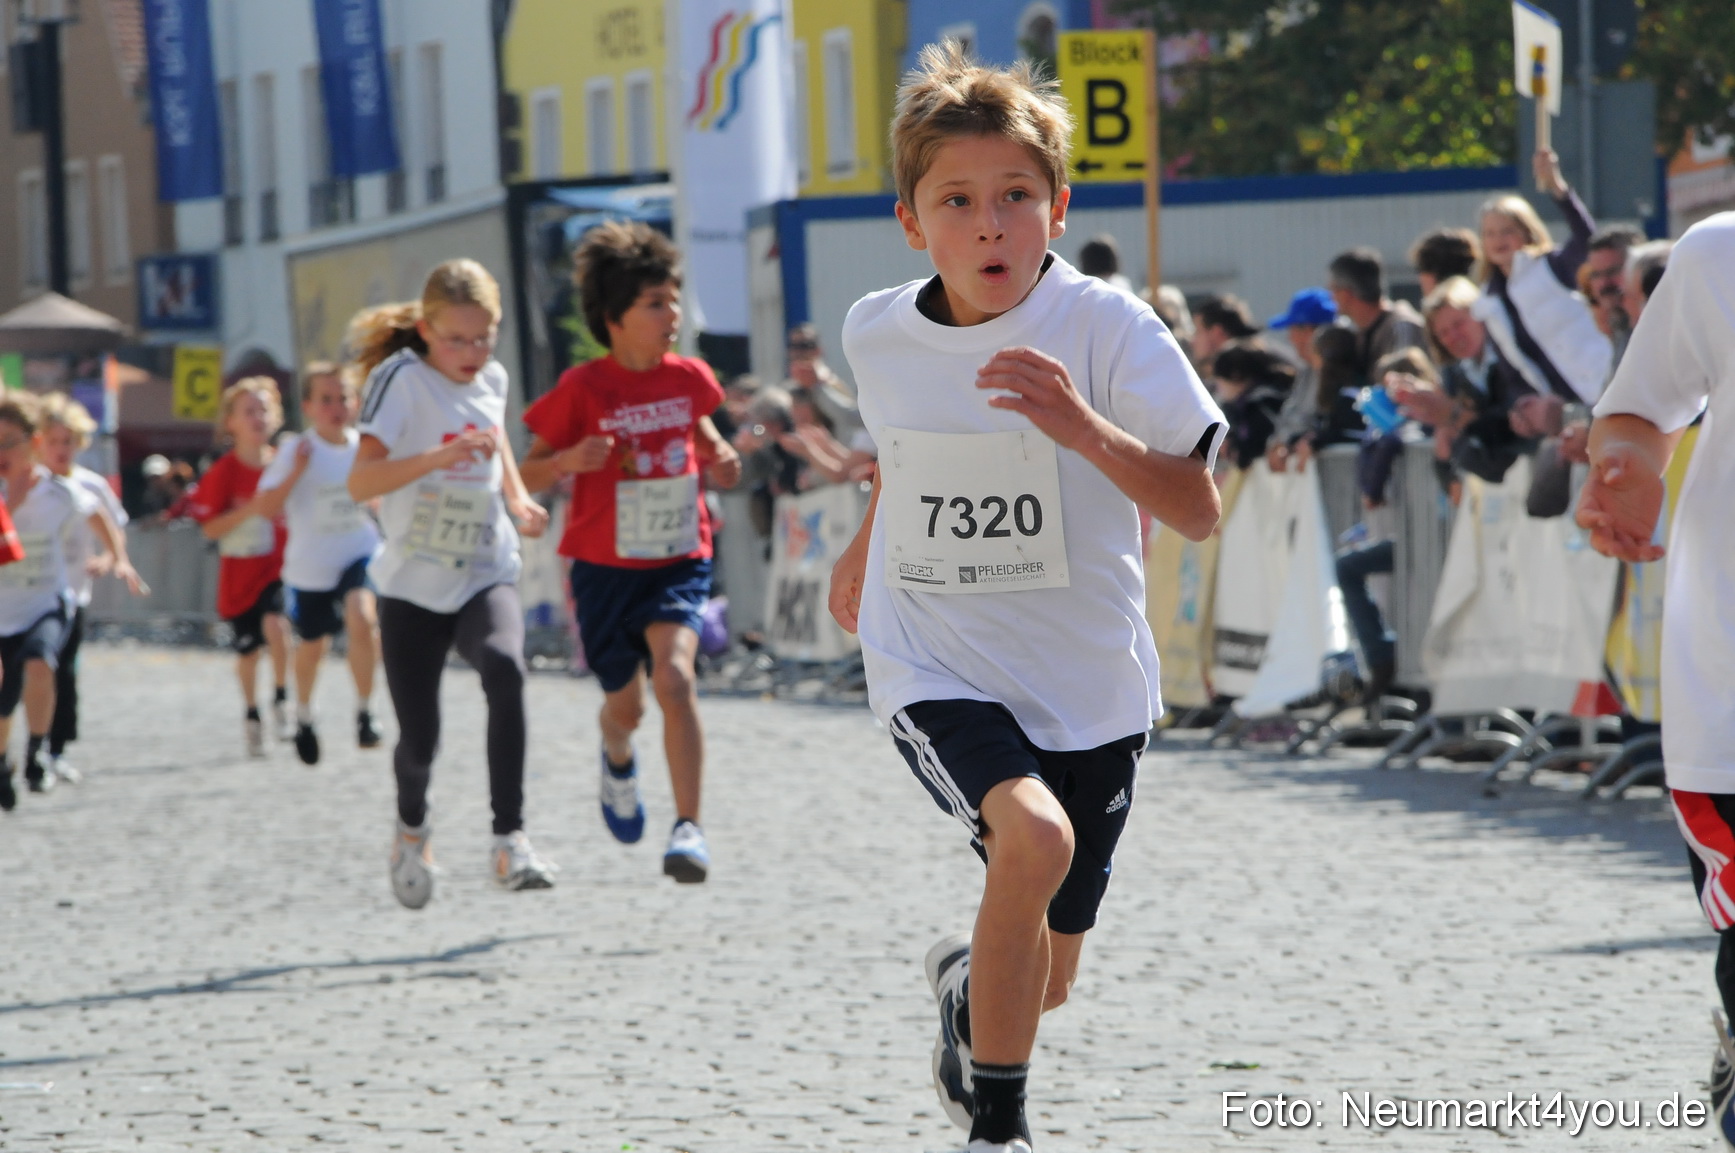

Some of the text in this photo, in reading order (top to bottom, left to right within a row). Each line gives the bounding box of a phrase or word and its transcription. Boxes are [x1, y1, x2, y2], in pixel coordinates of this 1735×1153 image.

[1069, 38, 1140, 66] Block
[1086, 79, 1132, 146] B
[185, 367, 212, 403] C
[920, 493, 1043, 540] 7320
[899, 562, 934, 578] BOCK
[978, 561, 1045, 577] PFLEIDERER
[979, 573, 1046, 584] AKTIENGESELLSCHAFT
[1105, 797, 1127, 814] adidas
